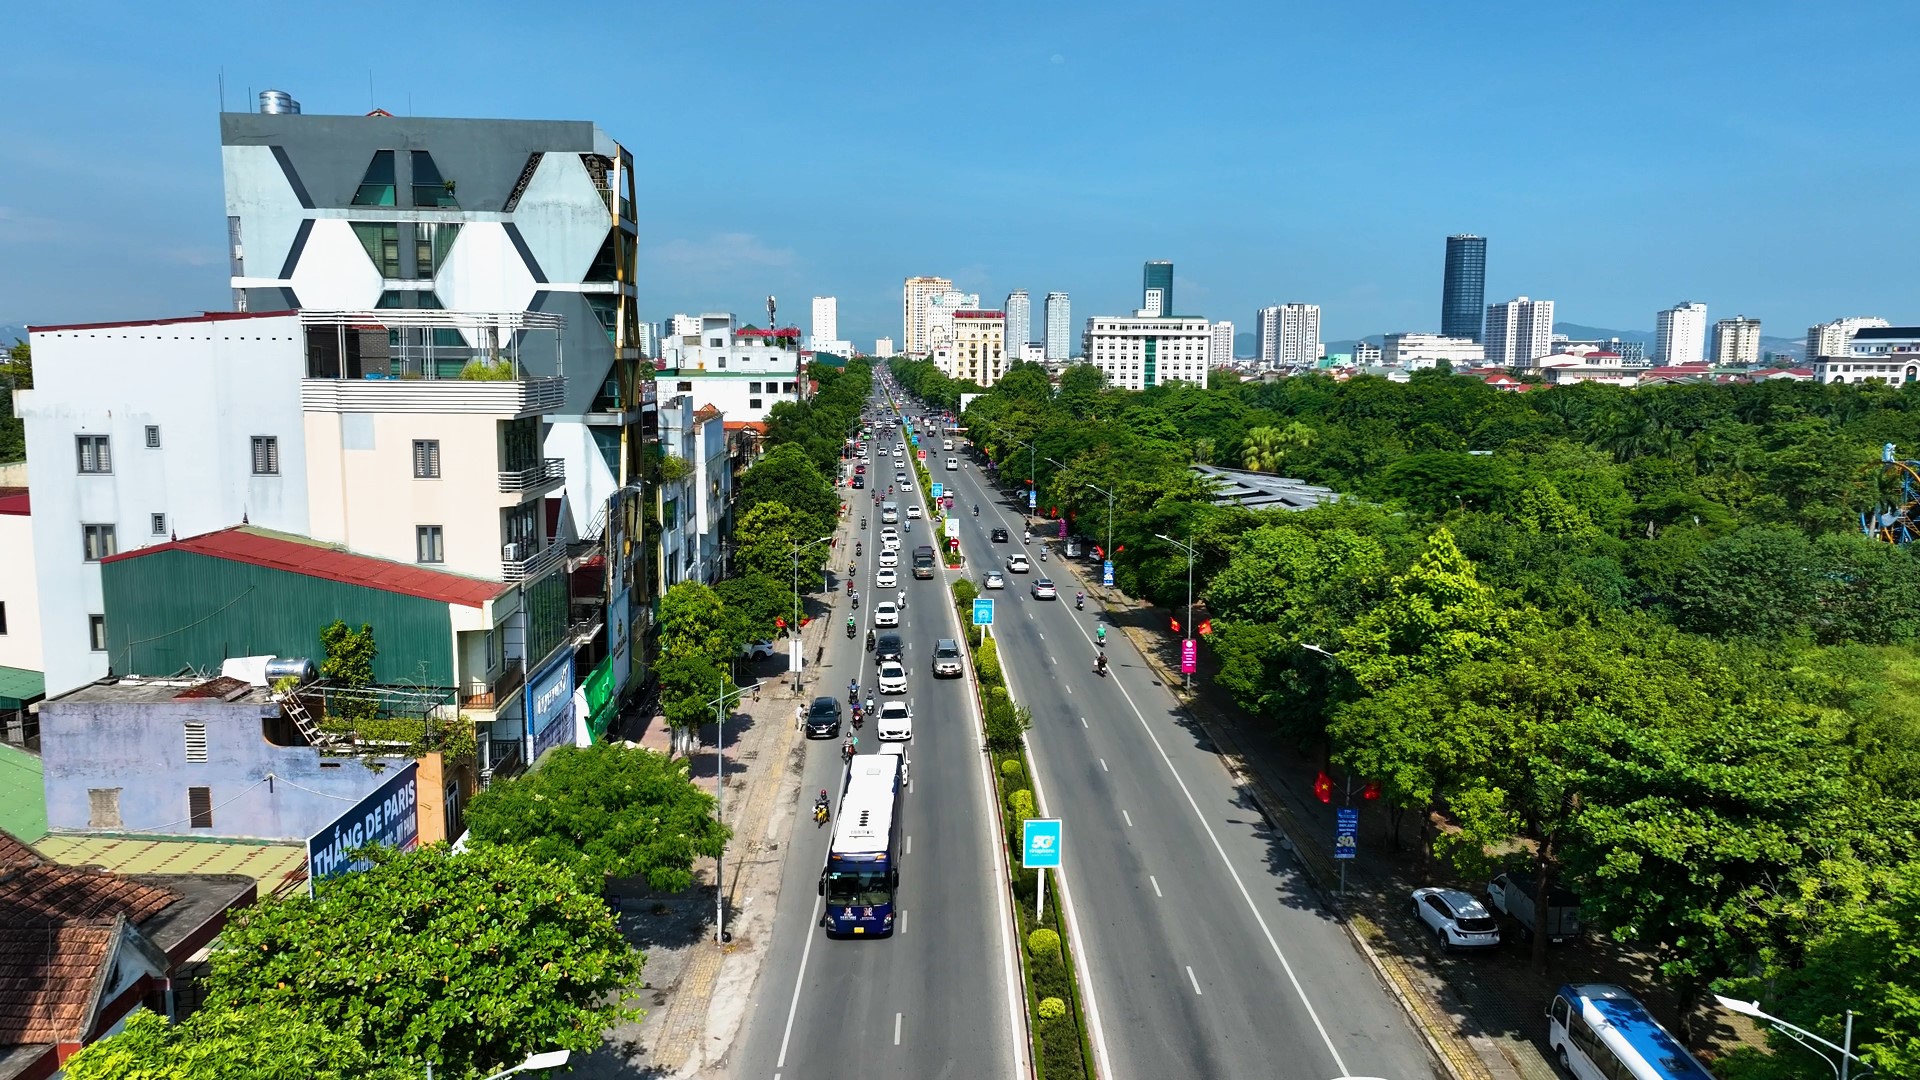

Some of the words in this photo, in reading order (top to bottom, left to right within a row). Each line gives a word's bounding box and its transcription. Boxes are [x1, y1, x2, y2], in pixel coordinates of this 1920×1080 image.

[314, 822, 363, 876] THẮNG
[366, 806, 382, 840] DE
[384, 780, 415, 824] PARIS
